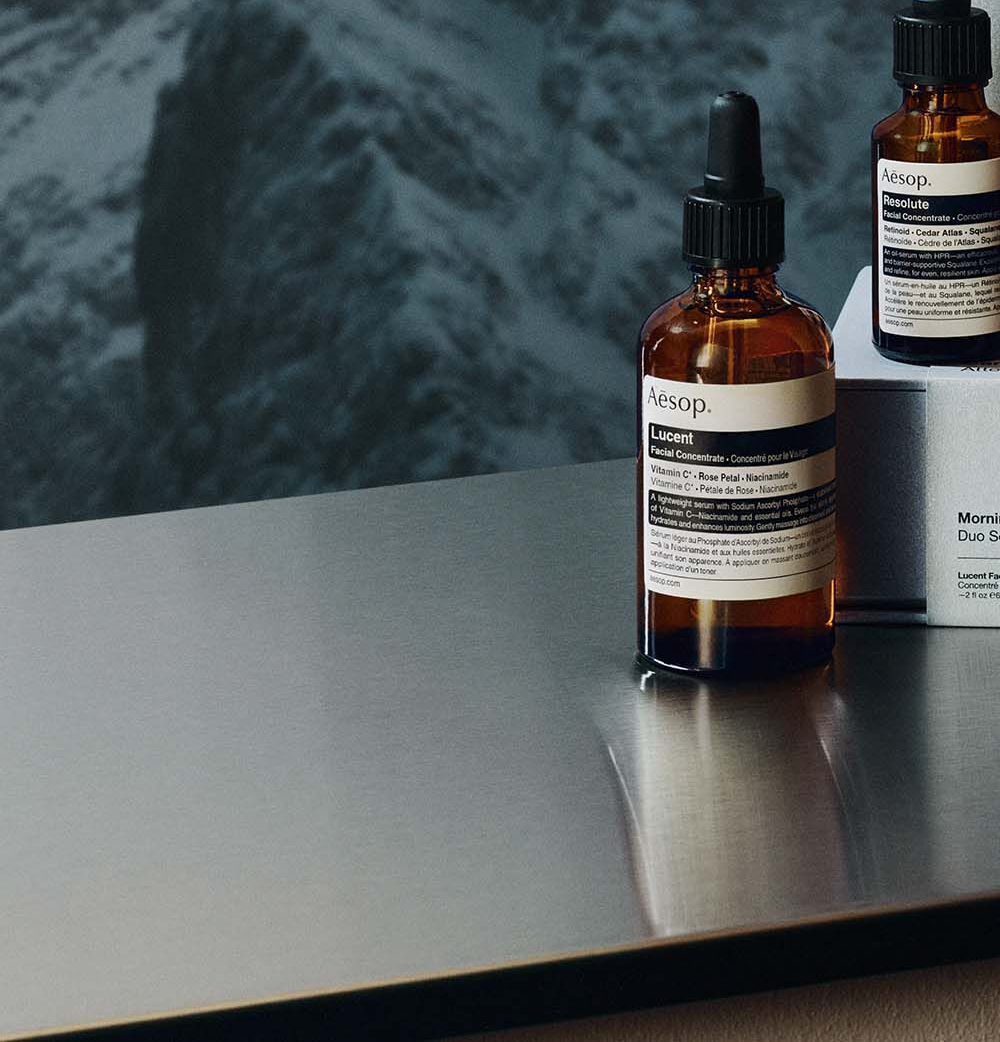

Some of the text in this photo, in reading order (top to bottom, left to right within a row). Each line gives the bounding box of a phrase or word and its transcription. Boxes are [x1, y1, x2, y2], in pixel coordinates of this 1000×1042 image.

[881, 167, 932, 190] Aēsop.
[883, 195, 930, 210] Resolute
[883, 210, 901, 219] Facial
[902, 212, 951, 222] Concentrate
[915, 228, 940, 237] Cedar
[942, 229, 963, 237] Atlas
[942, 239, 953, 247] de
[914, 300, 965, 308] renouvellement
[647, 385, 712, 419] Aēsop.
[650, 425, 694, 445] Lucent
[650, 445, 674, 458] Facial
[675, 449, 725, 463] Concentrate
[730, 453, 767, 463] Concentré
[650, 464, 681, 478] Vitamin
[698, 471, 719, 482] Rose
[720, 473, 740, 482] Petal
[746, 470, 789, 482] Niacinamide
[650, 477, 683, 490] Vitamine
[724, 486, 734, 495] de
[735, 485, 754, 495] Rose
[759, 481, 798, 494] Niacinamide
[650, 493, 656, 501] A
[657, 494, 693, 509] lightweight
[693, 501, 715, 509] serum
[715, 502, 730, 510] with
[731, 502, 755, 511] Sodium
[650, 504, 657, 512] of
[659, 505, 684, 517] Vitamin
[740, 513, 753, 521] and
[650, 514, 678, 527] hydrates
[678, 520, 692, 528] and
[692, 521, 724, 532] enhances
[697, 536, 730, 547] Phosphate
[761, 537, 769, 545] de
[957, 530, 985, 542] Duo
[670, 543, 710, 556] Niacinamide
[732, 548, 751, 556] huiles
[650, 559, 684, 572] application
[674, 555, 687, 563] son
[957, 571, 987, 580] Lucent
[957, 581, 999, 590] Concentré
[971, 591, 977, 599] fl
